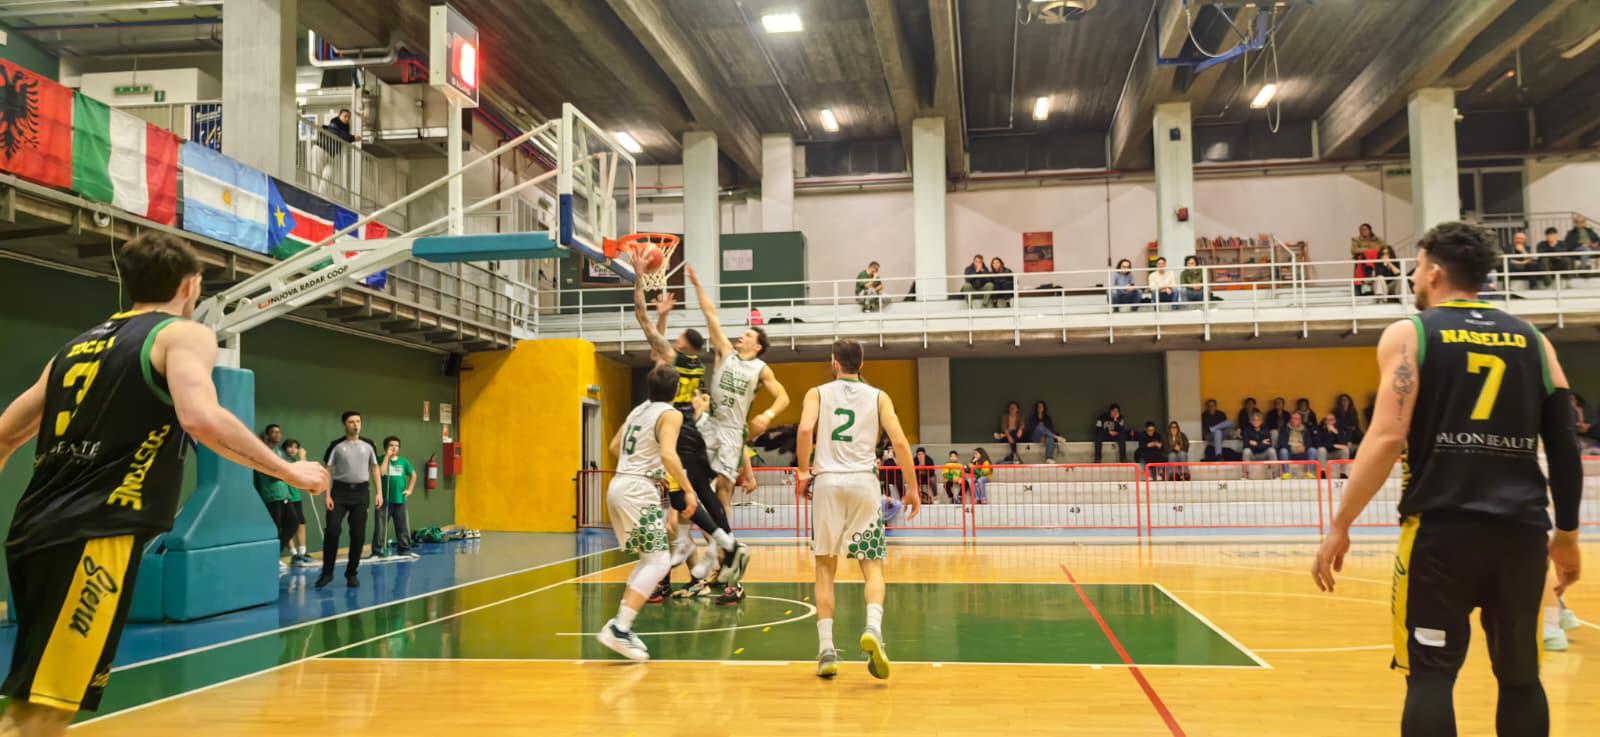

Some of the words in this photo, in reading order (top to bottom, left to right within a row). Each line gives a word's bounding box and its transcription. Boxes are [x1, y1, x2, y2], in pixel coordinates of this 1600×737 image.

[271, 287, 298, 303] NUOVA
[299, 274, 326, 292] RADAR
[327, 264, 349, 280] COOP
[1440, 329, 1528, 348] NASELLO
[720, 395, 735, 408] 29
[1467, 351, 1507, 420] 7
[622, 424, 641, 455] 15
[831, 407, 856, 443] 2
[69, 555, 118, 639] Siena
